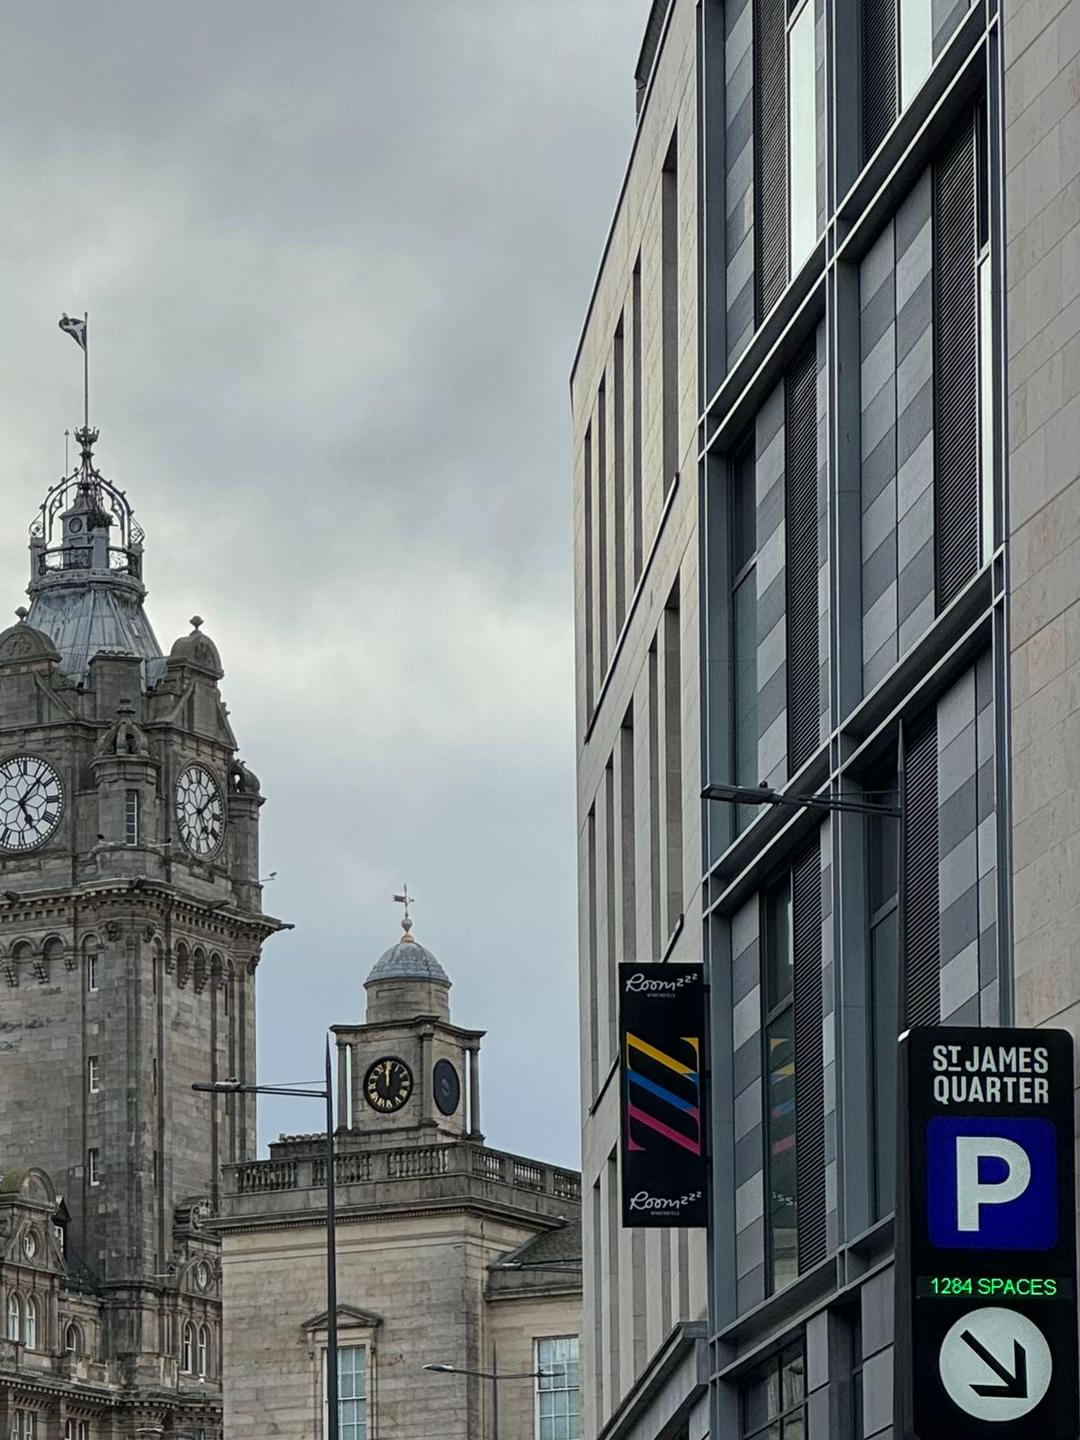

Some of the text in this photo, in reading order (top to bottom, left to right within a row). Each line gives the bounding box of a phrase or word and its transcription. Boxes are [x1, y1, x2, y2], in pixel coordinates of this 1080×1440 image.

[625, 973, 698, 992] Roomzzz
[932, 1044, 1049, 1074] ST JAMES
[933, 1075, 1049, 1104] QUARTER
[956, 1135, 1031, 1231] P
[629, 1191, 702, 1210] Roomzzz
[931, 1278, 1057, 1295] 1284 SPACES
